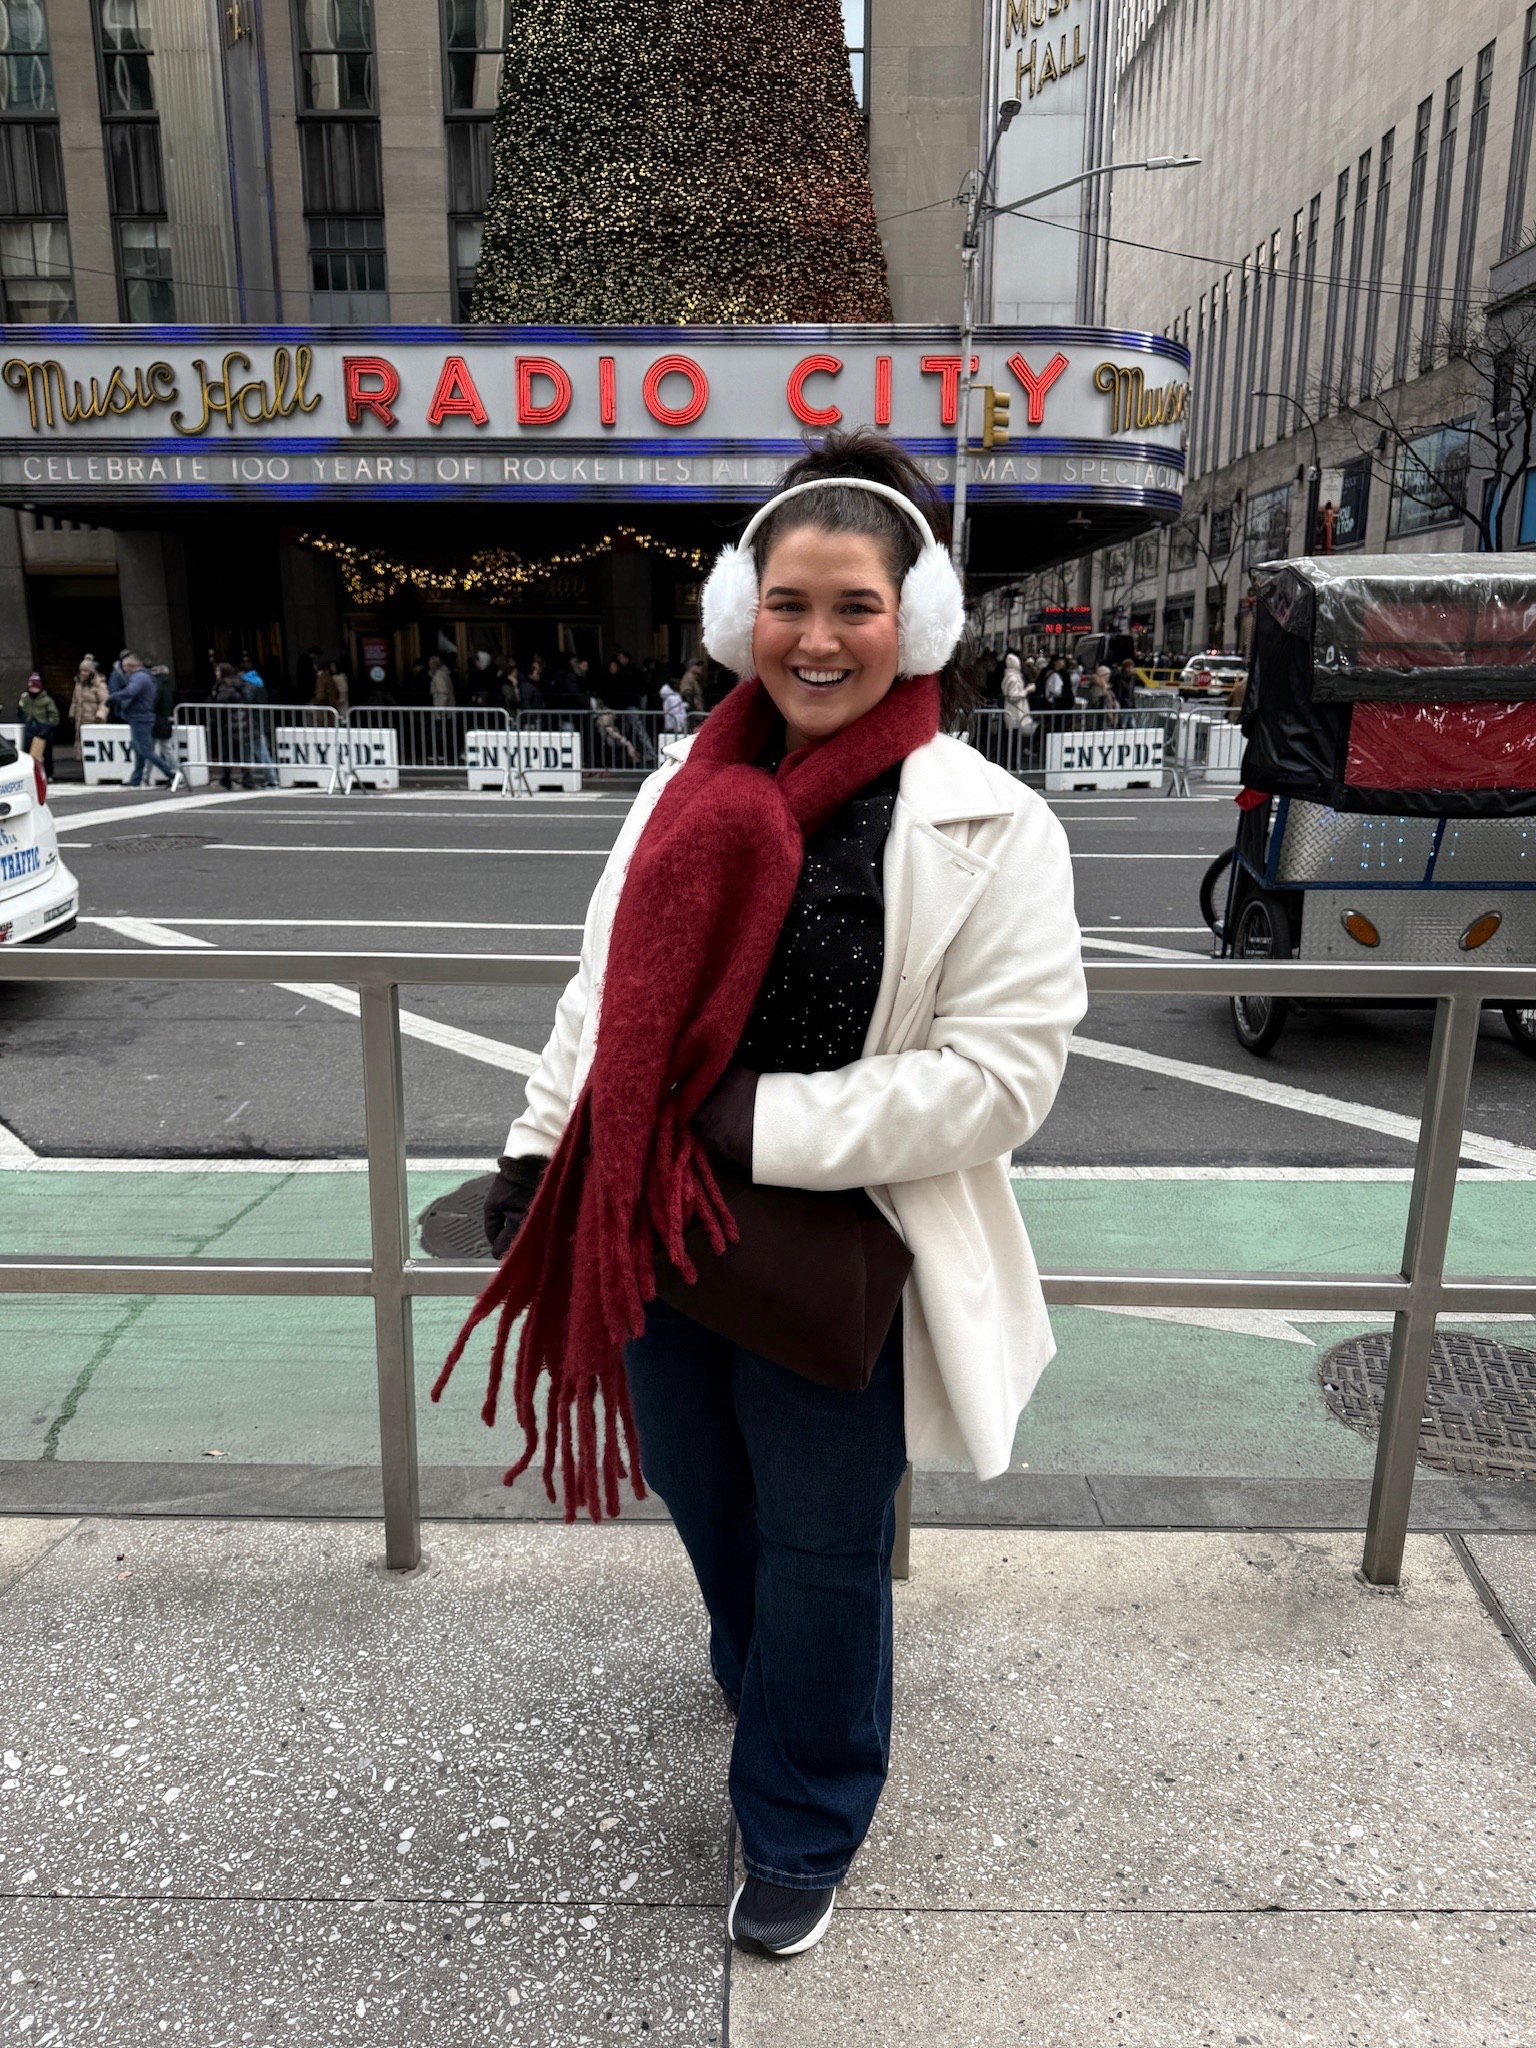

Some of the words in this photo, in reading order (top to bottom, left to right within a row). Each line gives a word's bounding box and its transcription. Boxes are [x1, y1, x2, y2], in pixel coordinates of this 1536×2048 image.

[1015, 24, 1086, 99] HALL
[2, 359, 178, 432] Music
[170, 344, 323, 435] Hall
[342, 353, 710, 428] RADIO
[786, 351, 1070, 427] CITY
[23, 456, 207, 481] CELEBRATE
[231, 456, 290, 481] 100
[313, 457, 413, 481] YEARS
[436, 457, 478, 481] OF
[503, 457, 690, 482] ROCKETTES
[713, 458, 749, 481] AT
[292, 743, 372, 765] NYPD
[483, 745, 560, 769] NYPD
[1077, 743, 1150, 768] NYPD
[1, 846, 40, 881] TRAFFIC
